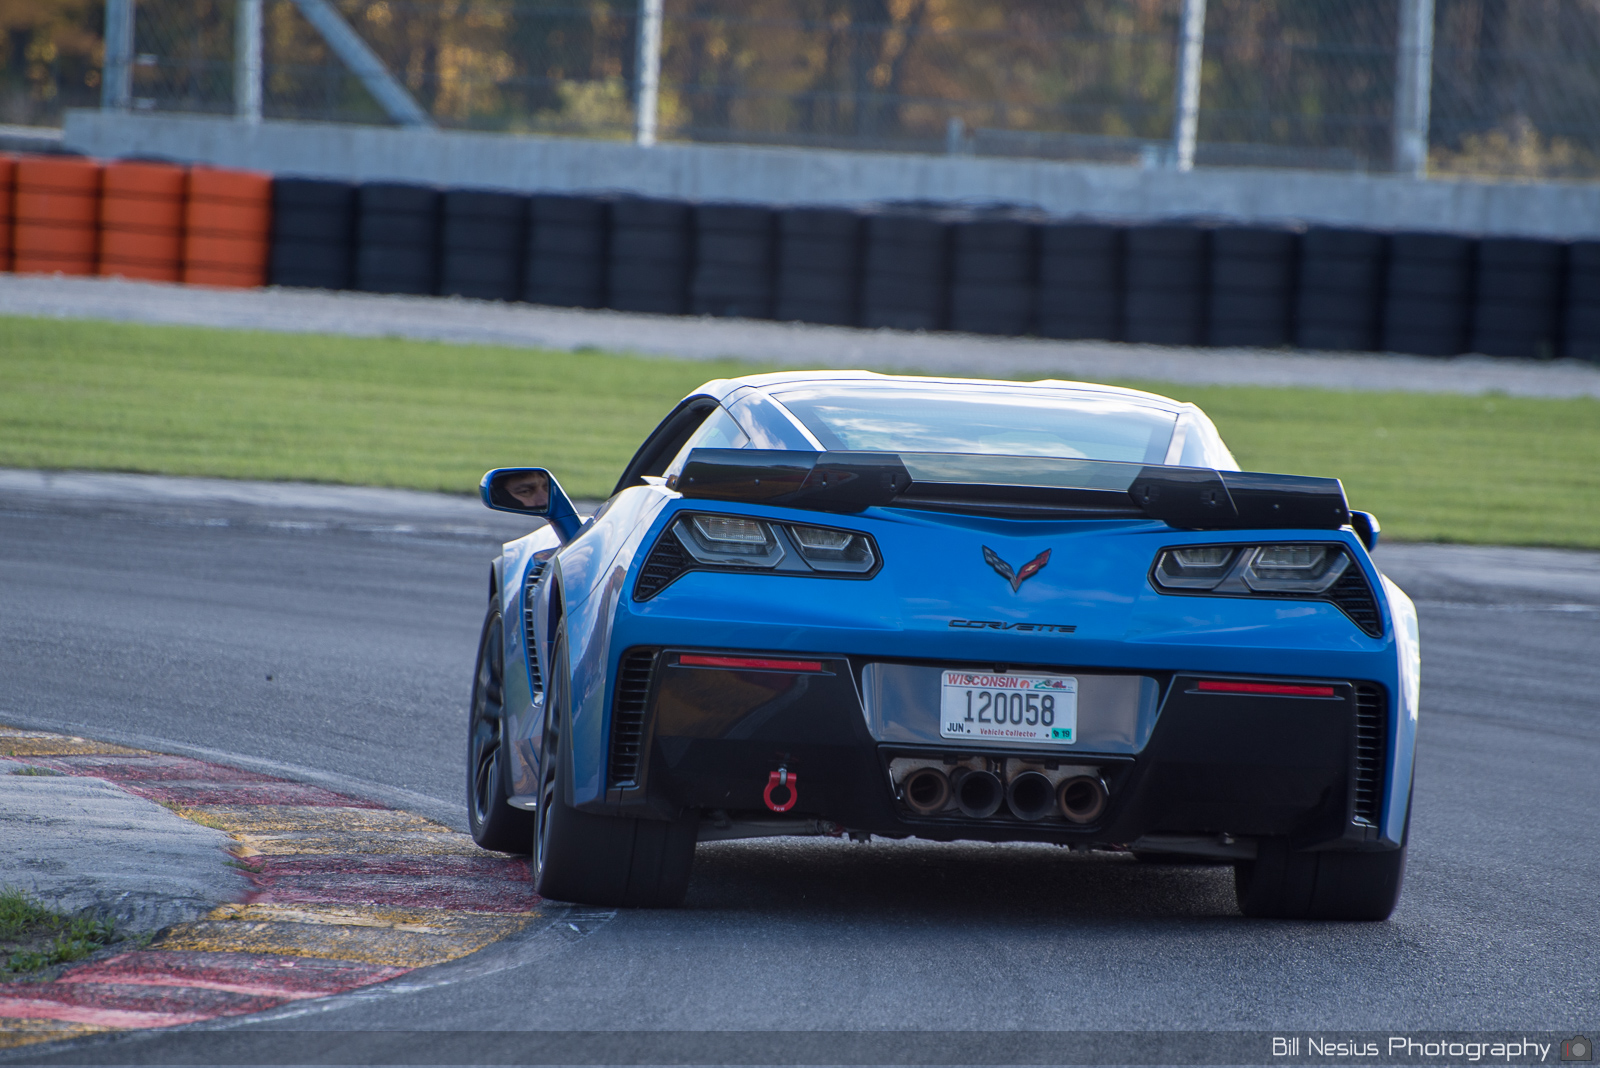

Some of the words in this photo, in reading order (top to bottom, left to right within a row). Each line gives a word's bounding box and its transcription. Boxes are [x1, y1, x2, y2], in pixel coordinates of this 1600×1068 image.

[948, 619, 1077, 633] CORVETTE
[948, 674, 1019, 688] WISCONSIN
[964, 690, 1055, 727] 120058
[947, 722, 964, 733] JUN
[980, 728, 1005, 736] Vehicle
[1005, 729, 1037, 738] Collector
